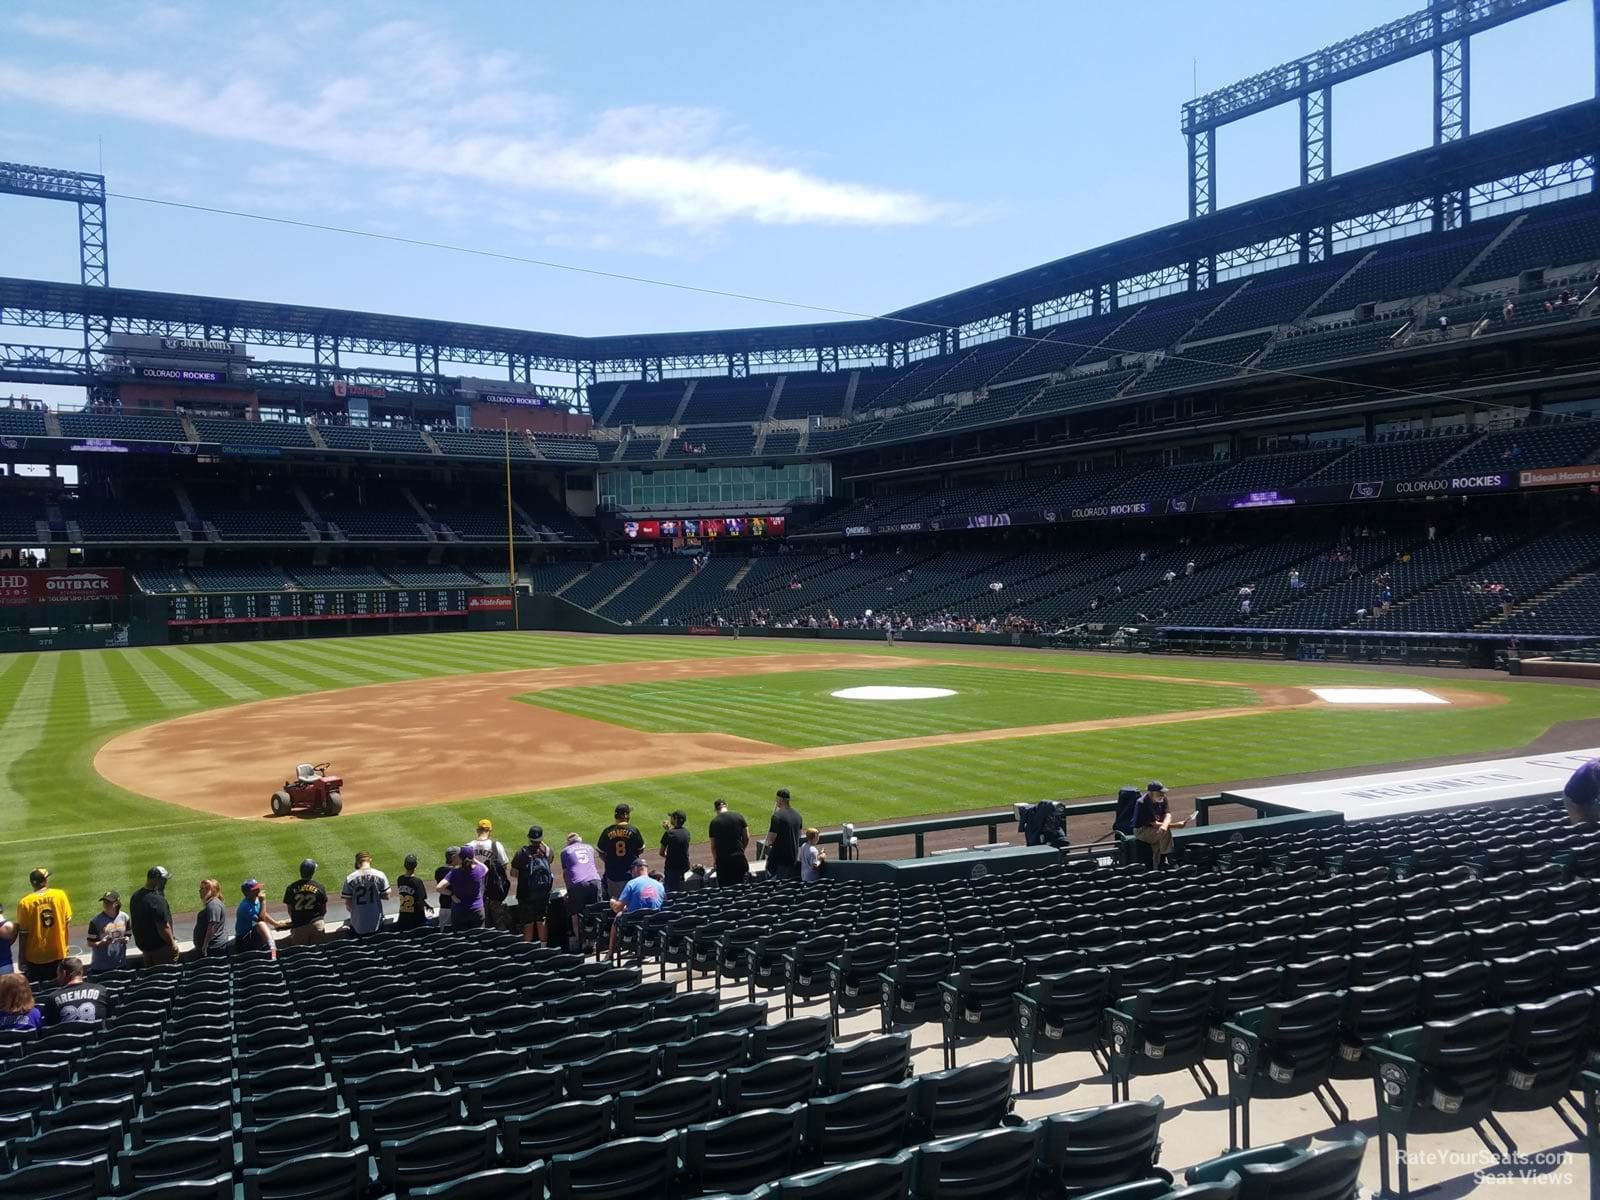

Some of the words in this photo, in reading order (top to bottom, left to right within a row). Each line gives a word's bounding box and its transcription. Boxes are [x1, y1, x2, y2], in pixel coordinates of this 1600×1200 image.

[144, 369, 180, 378] COLORADO
[183, 372, 216, 380] ROCKIES
[487, 396, 515, 404] COLORADO
[1396, 480, 1448, 492] COLORADO
[1452, 476, 1501, 488] ROCKIES
[1532, 473, 1556, 482] Ideal
[1560, 472, 1589, 480] Home
[1072, 507, 1108, 518] COLORADO
[1110, 504, 1146, 514] ROCKIES
[46, 580, 110, 590] OUTBACK
[1343, 778, 1486, 800] WELCOME
[616, 841, 626, 856] 8
[576, 850, 589, 864] 5
[294, 894, 316, 910] 22
[356, 886, 374, 904] 21
[41, 909, 54, 928] 6
[55, 989, 99, 1006] ARENADO
